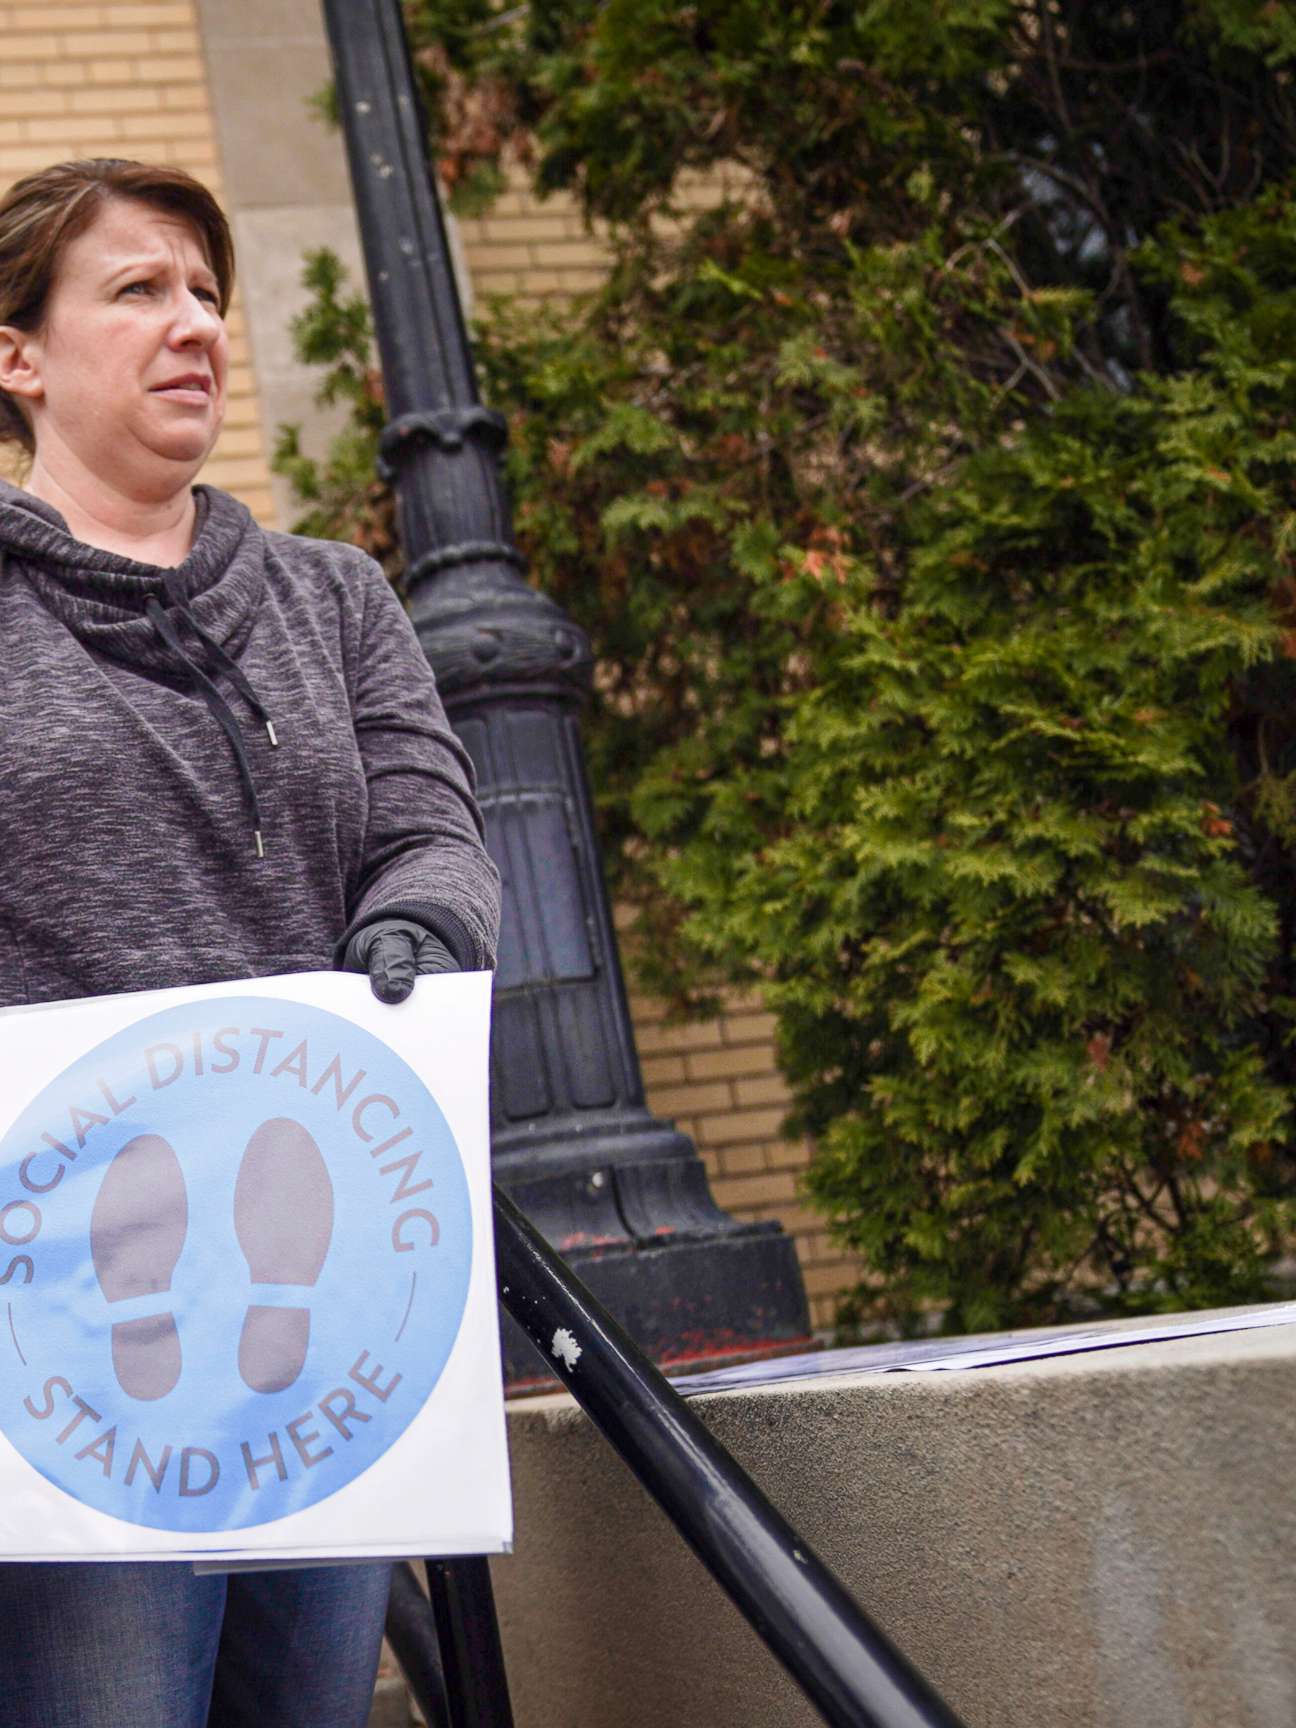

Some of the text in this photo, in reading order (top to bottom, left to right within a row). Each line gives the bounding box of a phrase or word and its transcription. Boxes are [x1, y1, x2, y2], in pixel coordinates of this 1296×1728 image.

[143, 1027, 441, 1253] DISTANCING
[23, 1349, 403, 1498] STAND HERE
